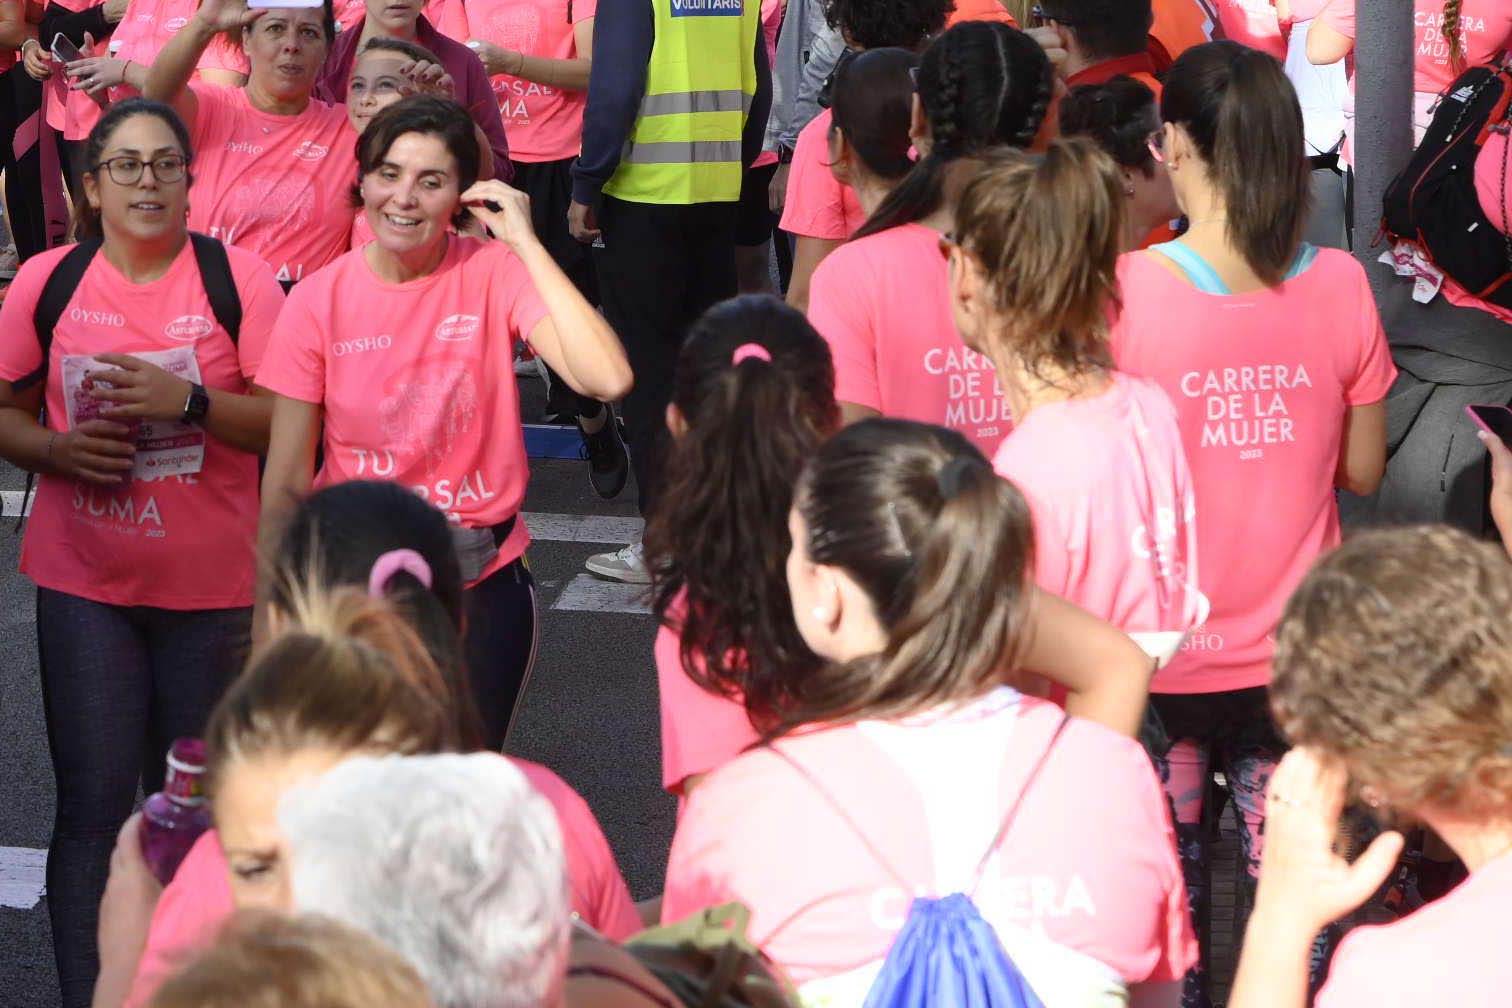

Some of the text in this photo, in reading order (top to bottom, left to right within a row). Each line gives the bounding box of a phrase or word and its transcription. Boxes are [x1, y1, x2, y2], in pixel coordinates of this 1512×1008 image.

[71, 308, 126, 328] OYSHO
[333, 333, 393, 357] OYSHO
[947, 373, 983, 401] DE
[1180, 363, 1313, 399] CARRERA
[944, 400, 1014, 429] MUJE
[1206, 393, 1289, 422] DE LA
[1200, 418, 1297, 448] MUJER
[351, 448, 394, 477] TU
[1239, 447, 1264, 460] 2023
